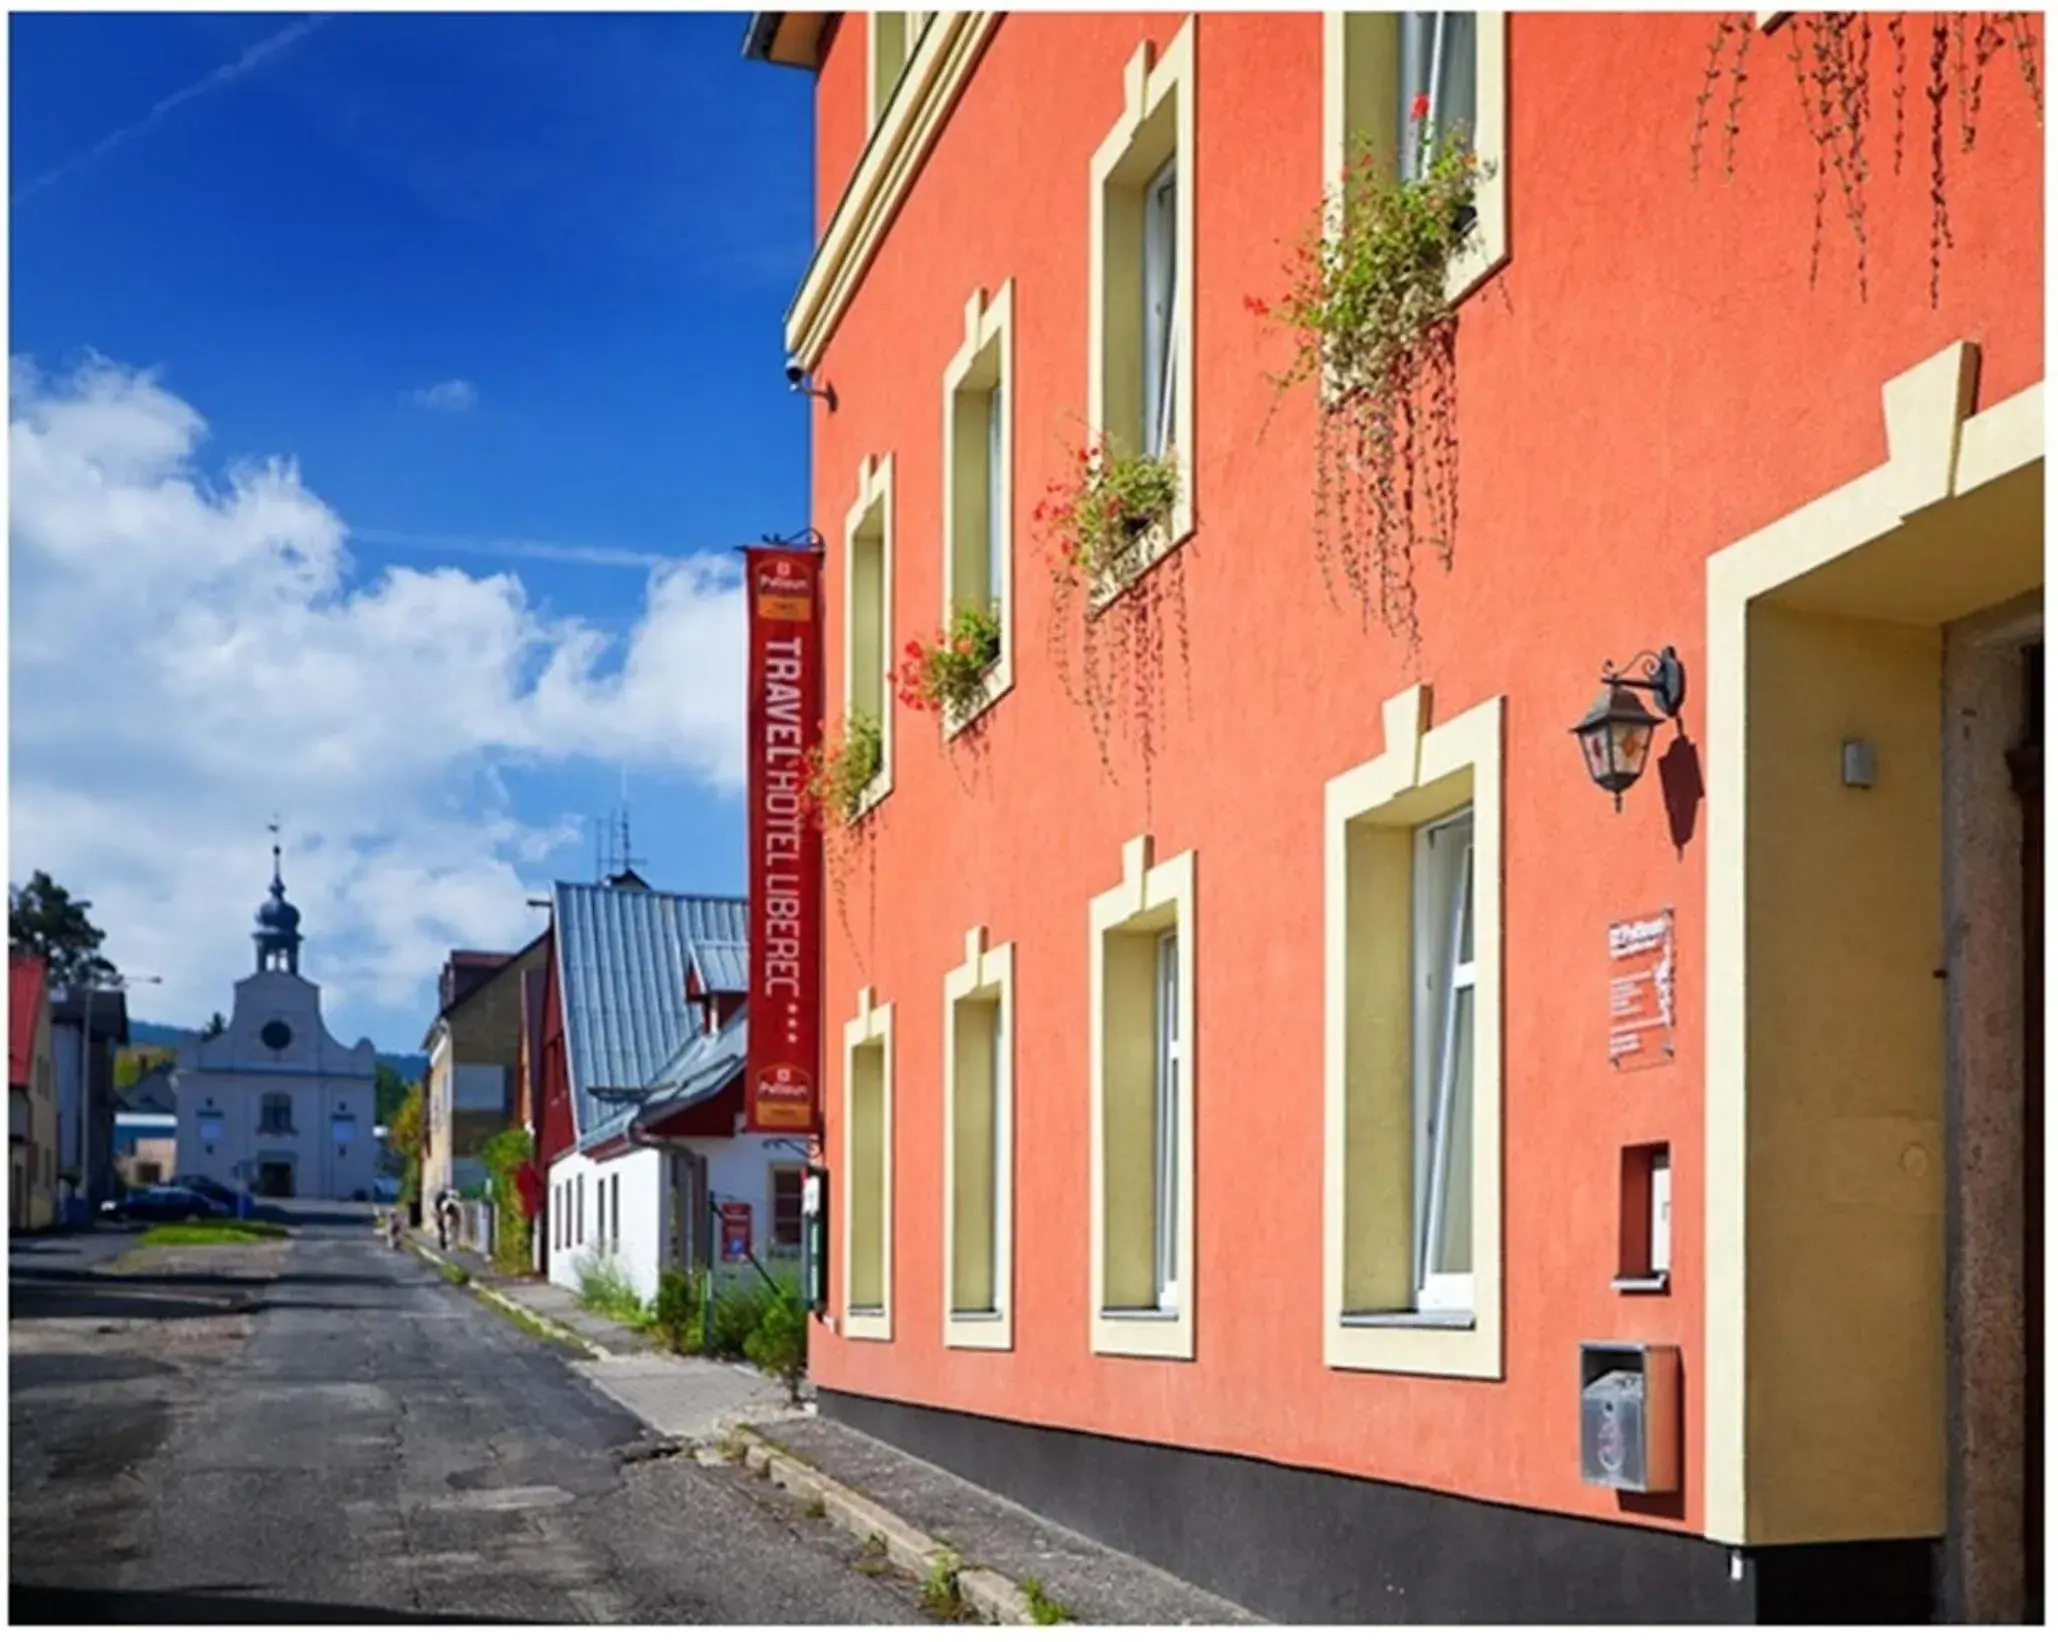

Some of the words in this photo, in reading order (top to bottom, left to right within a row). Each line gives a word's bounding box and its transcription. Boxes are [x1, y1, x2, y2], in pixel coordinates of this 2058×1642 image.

[766, 637, 803, 763] TRAVEL
[765, 770, 801, 866] HOTEL
[765, 874, 801, 998] LIBEREC
